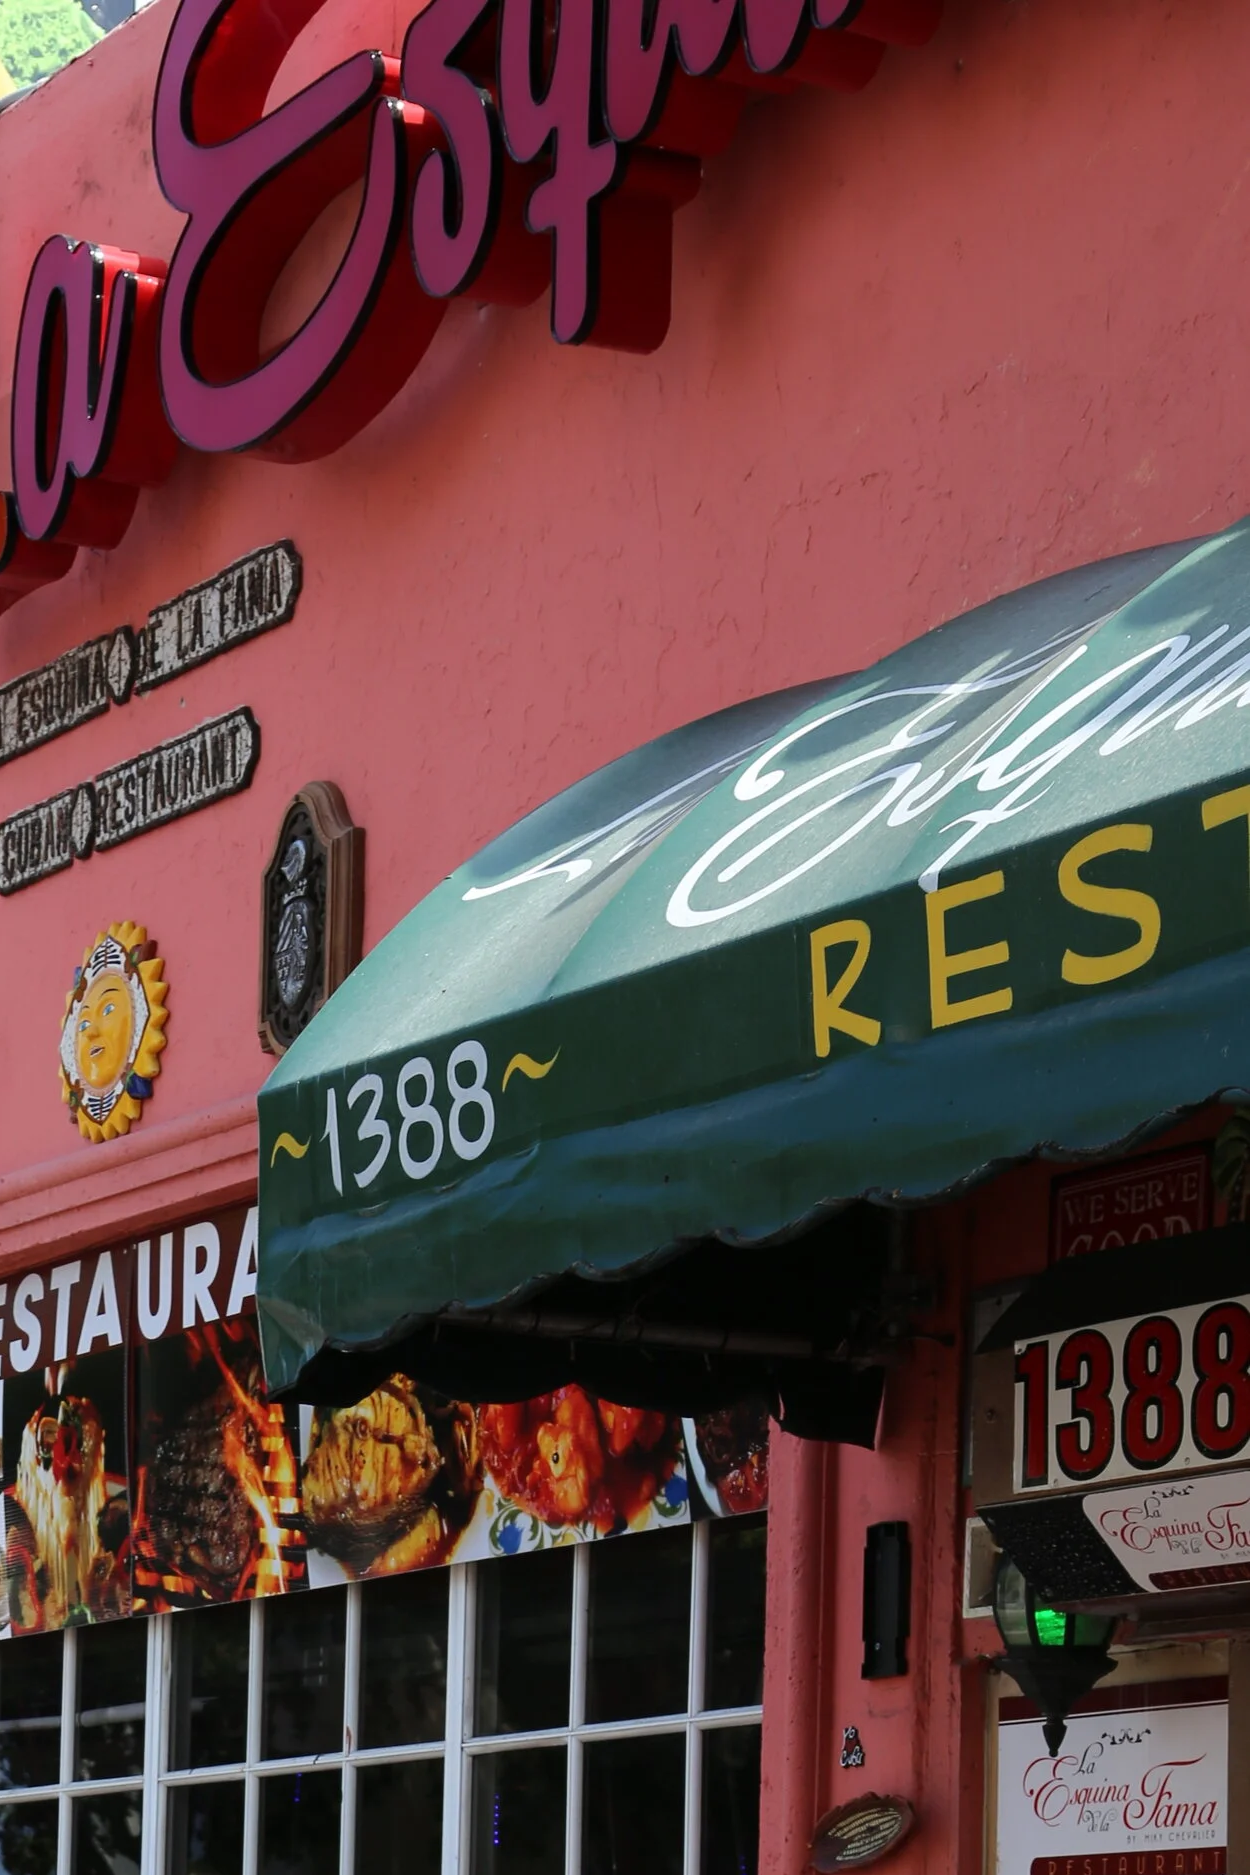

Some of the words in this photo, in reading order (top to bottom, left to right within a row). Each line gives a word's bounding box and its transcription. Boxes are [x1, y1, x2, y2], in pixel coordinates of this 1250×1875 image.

[2, 800, 73, 876] CUBAN
[95, 724, 242, 840] RESTAURANT
[320, 1040, 496, 1197] 1388
[1113, 1172, 1199, 1215] SERVE
[1014, 1301, 1250, 1489] 1388
[1100, 1506, 1203, 1554] Esquina
[1073, 1741, 1104, 1776] La
[1023, 1755, 1131, 1827] Esquina
[1123, 1752, 1220, 1831] Fama
[1168, 1829, 1216, 1842] CHEVALIER
